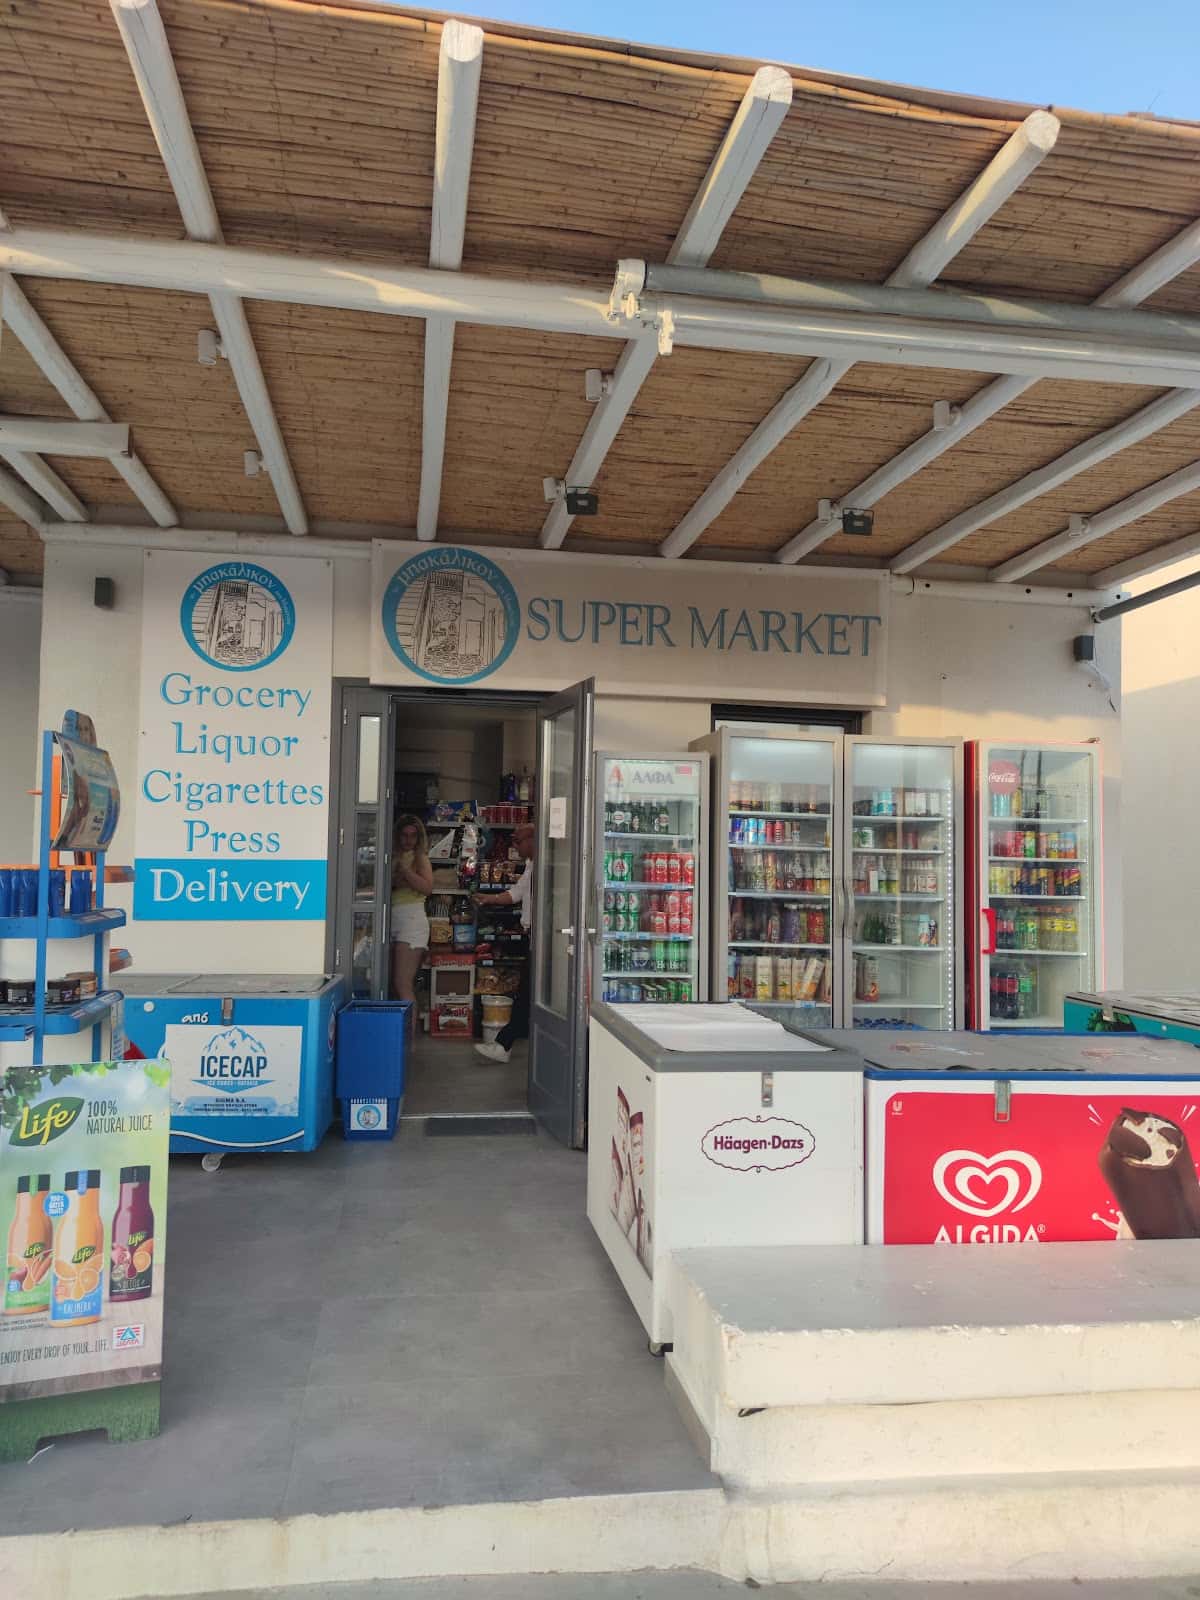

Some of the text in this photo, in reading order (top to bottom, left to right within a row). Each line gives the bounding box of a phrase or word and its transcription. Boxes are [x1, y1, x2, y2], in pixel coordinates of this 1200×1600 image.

[527, 598, 675, 647] SUPER
[688, 606, 881, 657] MARKET
[160, 673, 311, 716] Grocery
[171, 721, 299, 763] Liquor
[142, 769, 324, 811] Cigarettes
[184, 820, 280, 853] Press
[150, 868, 310, 910] Delivery
[200, 1056, 267, 1077] ICECAP
[19, 1103, 76, 1145] Life
[86, 1114, 152, 1135] NATURAL JUICE
[87, 1100, 117, 1118] 100%
[0, 1350, 21, 1365] ENJOY
[23, 1347, 42, 1362] EVERY
[44, 1345, 61, 1359] DROP
[62, 1344, 71, 1357] OF
